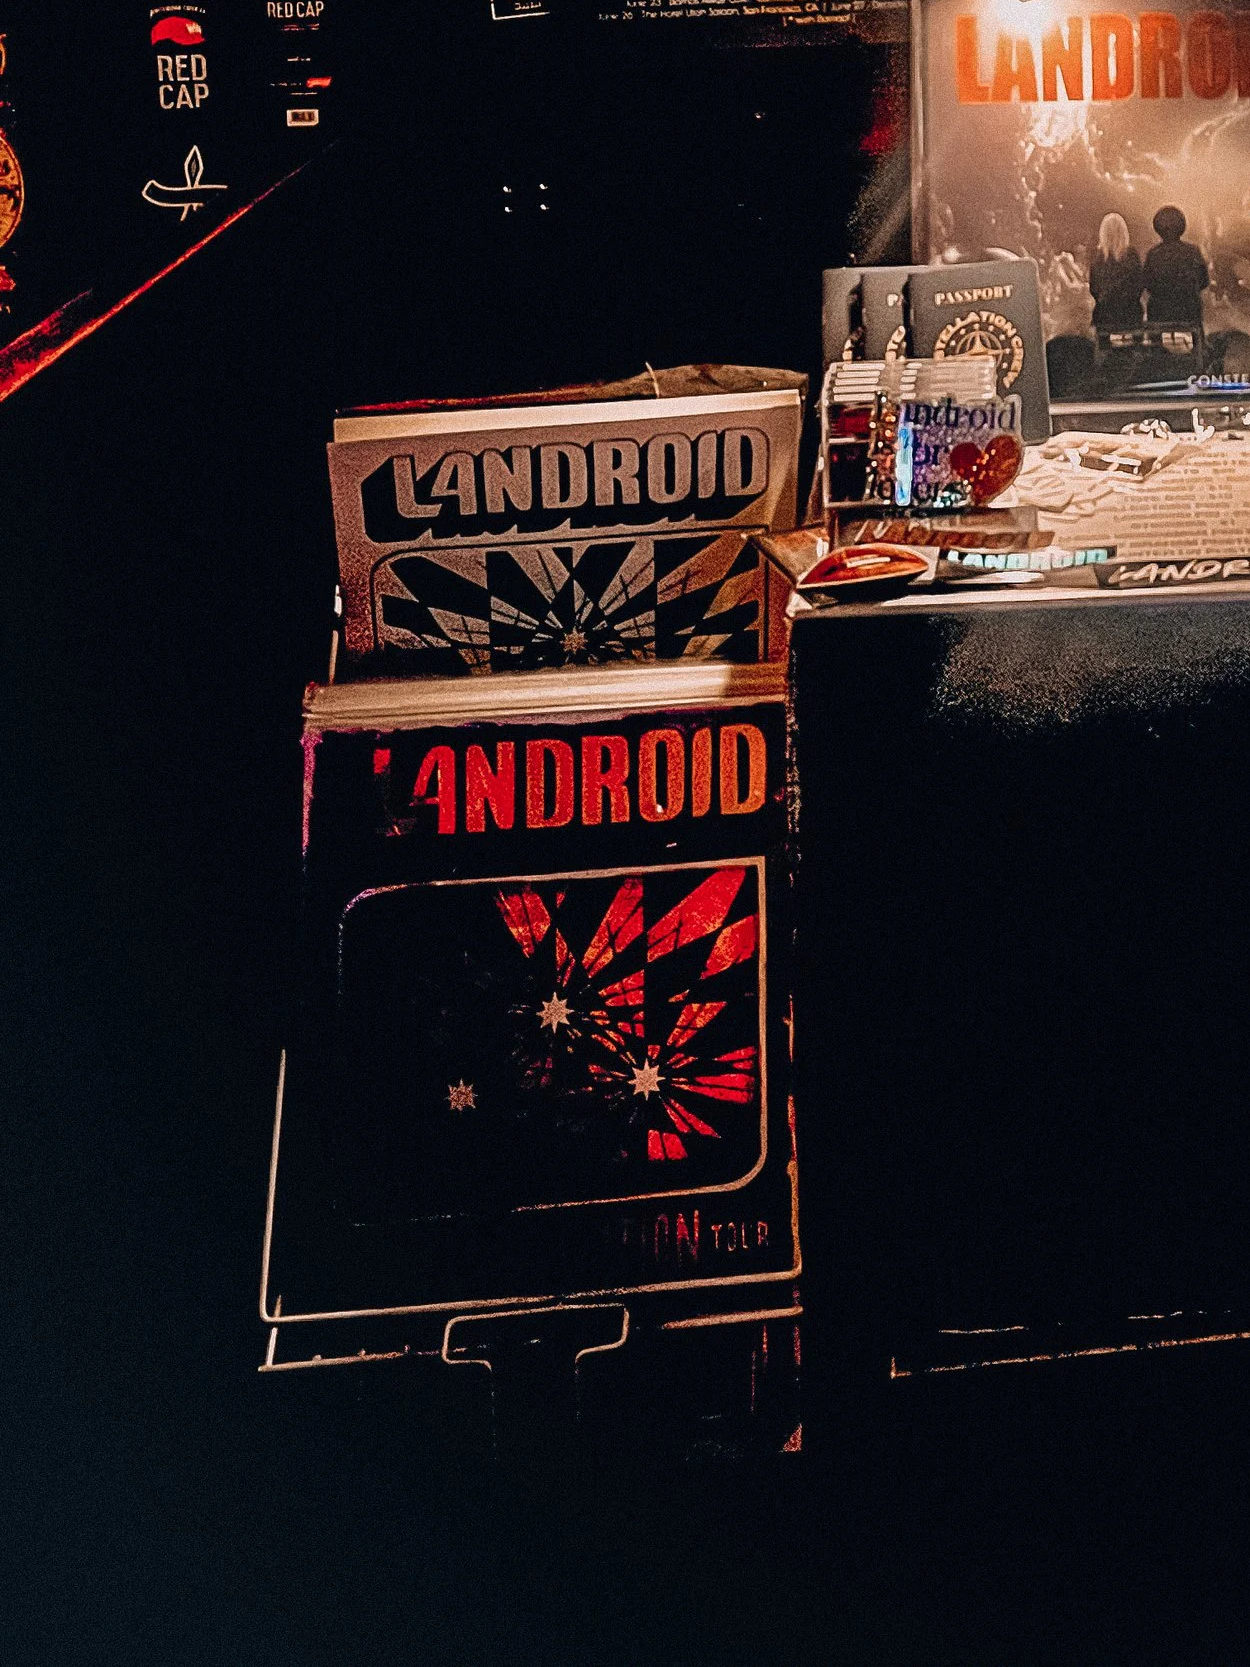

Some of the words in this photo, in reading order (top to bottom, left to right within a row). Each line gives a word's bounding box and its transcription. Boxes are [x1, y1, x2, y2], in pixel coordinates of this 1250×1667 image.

[267, 1, 293, 18] RED
[296, 0, 324, 18] CAP
[157, 54, 208, 82] RED
[158, 83, 210, 110] CAP
[934, 284, 1014, 306] PASSPORT
[394, 429, 769, 520] LANDROID
[372, 723, 768, 838] ANDROID
